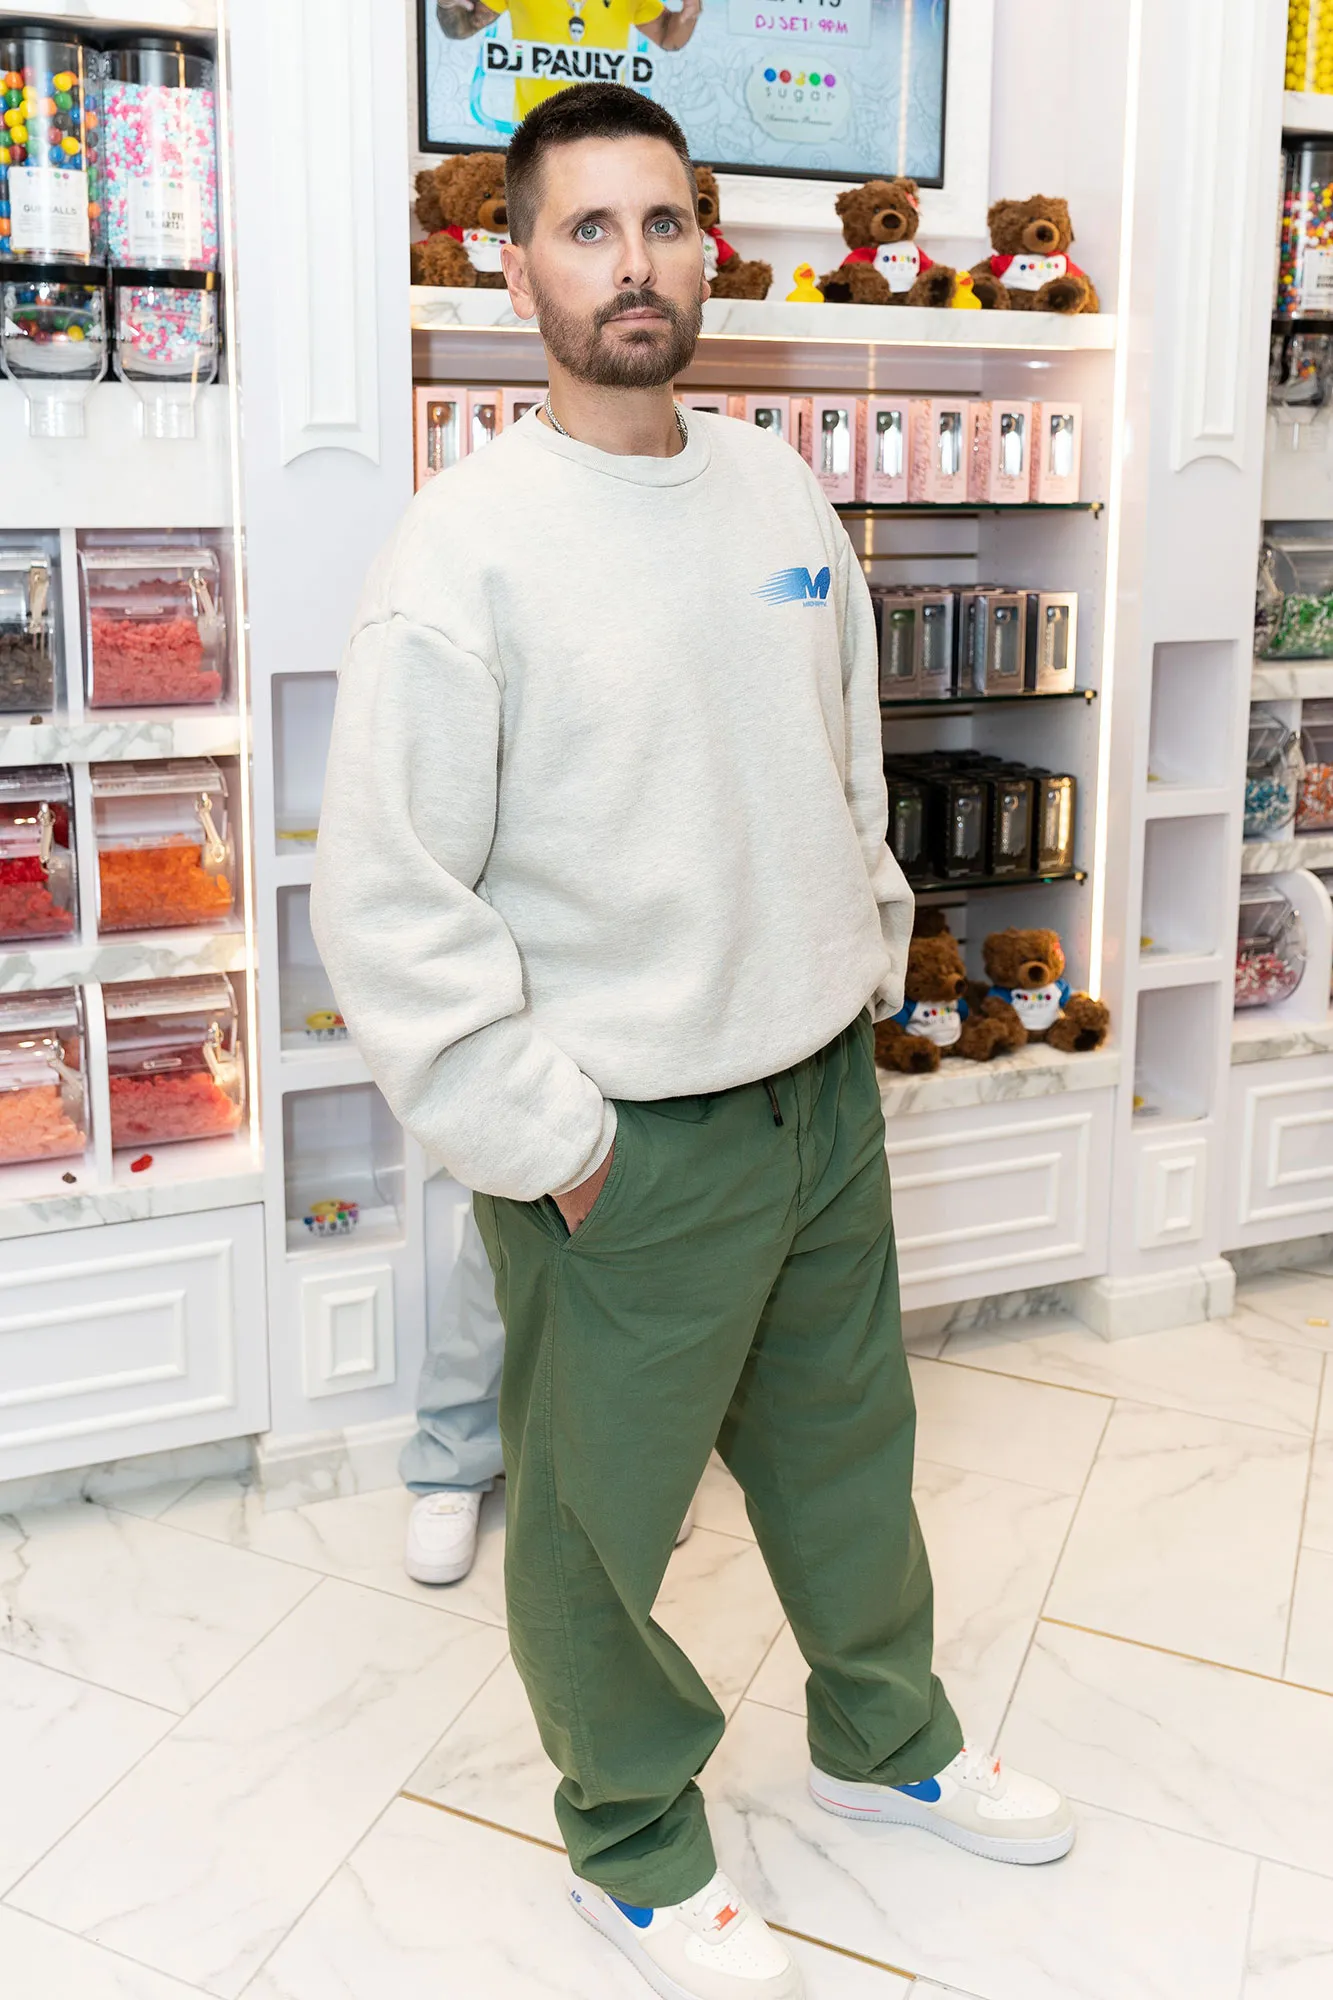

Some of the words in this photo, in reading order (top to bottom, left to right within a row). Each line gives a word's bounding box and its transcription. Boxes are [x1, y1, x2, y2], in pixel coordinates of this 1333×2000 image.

[755, 14, 775, 29] DJ
[532, 47, 625, 80] PAULY
[633, 56, 654, 83] D
[766, 86, 836, 103] sugar
[23, 204, 78, 215] GUALLS
